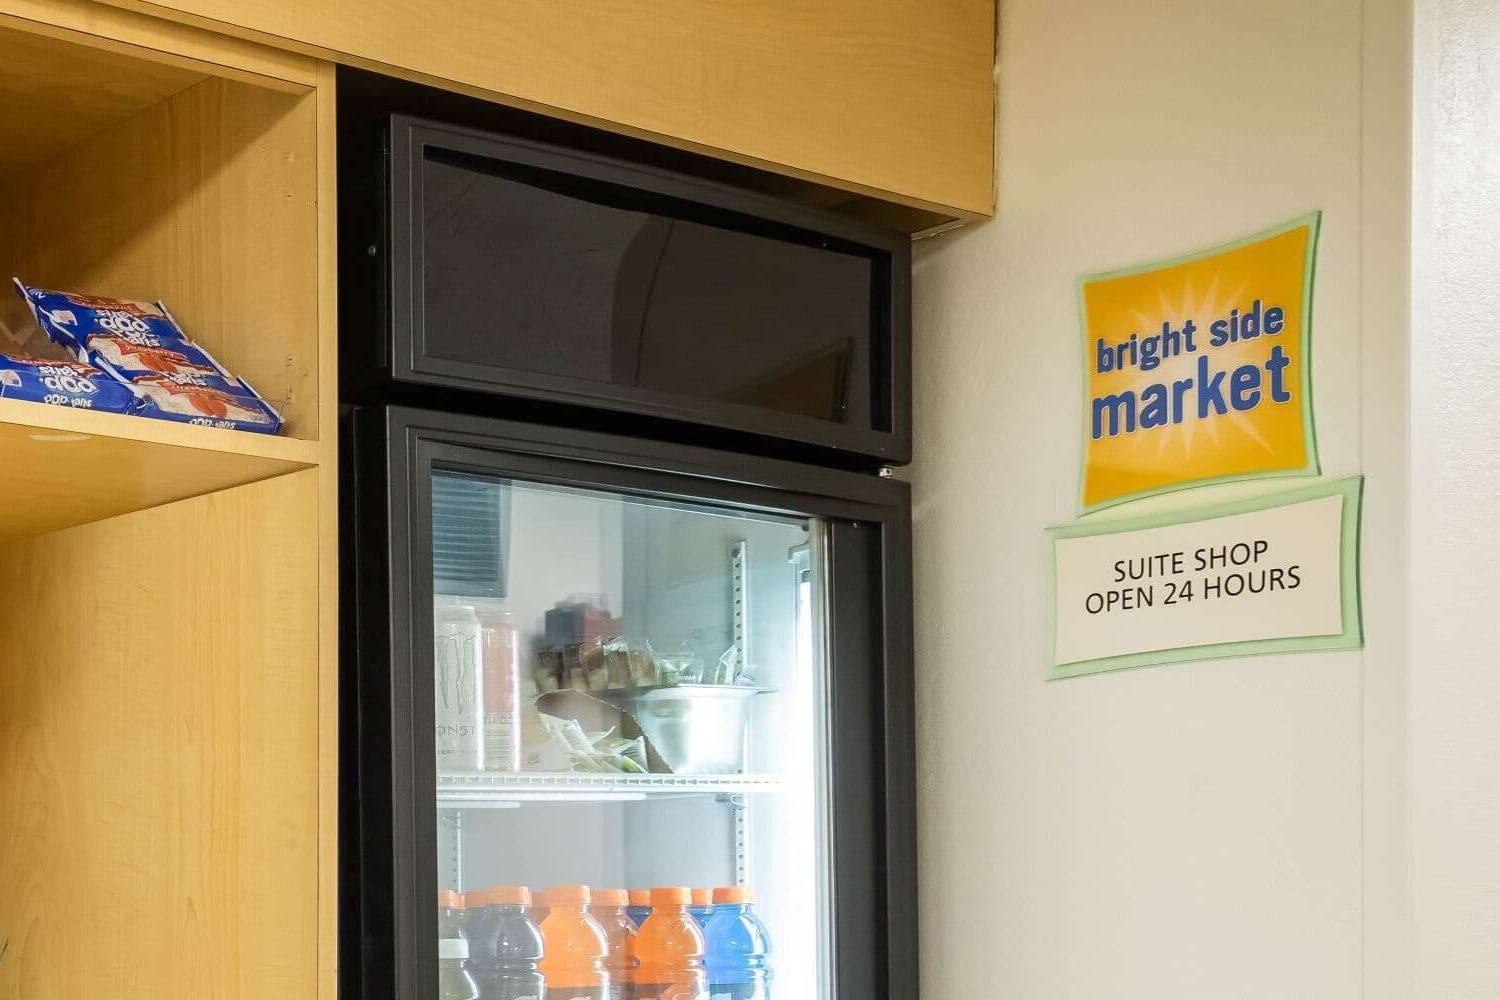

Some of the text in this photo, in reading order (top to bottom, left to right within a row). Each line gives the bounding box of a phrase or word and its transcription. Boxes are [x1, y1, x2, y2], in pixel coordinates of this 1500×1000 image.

[1097, 300, 1284, 373] bright side
[1091, 345, 1290, 439] market
[1085, 566, 1300, 615] OPEN 24 HOURS
[1114, 540, 1268, 583] SUITE SHOP
